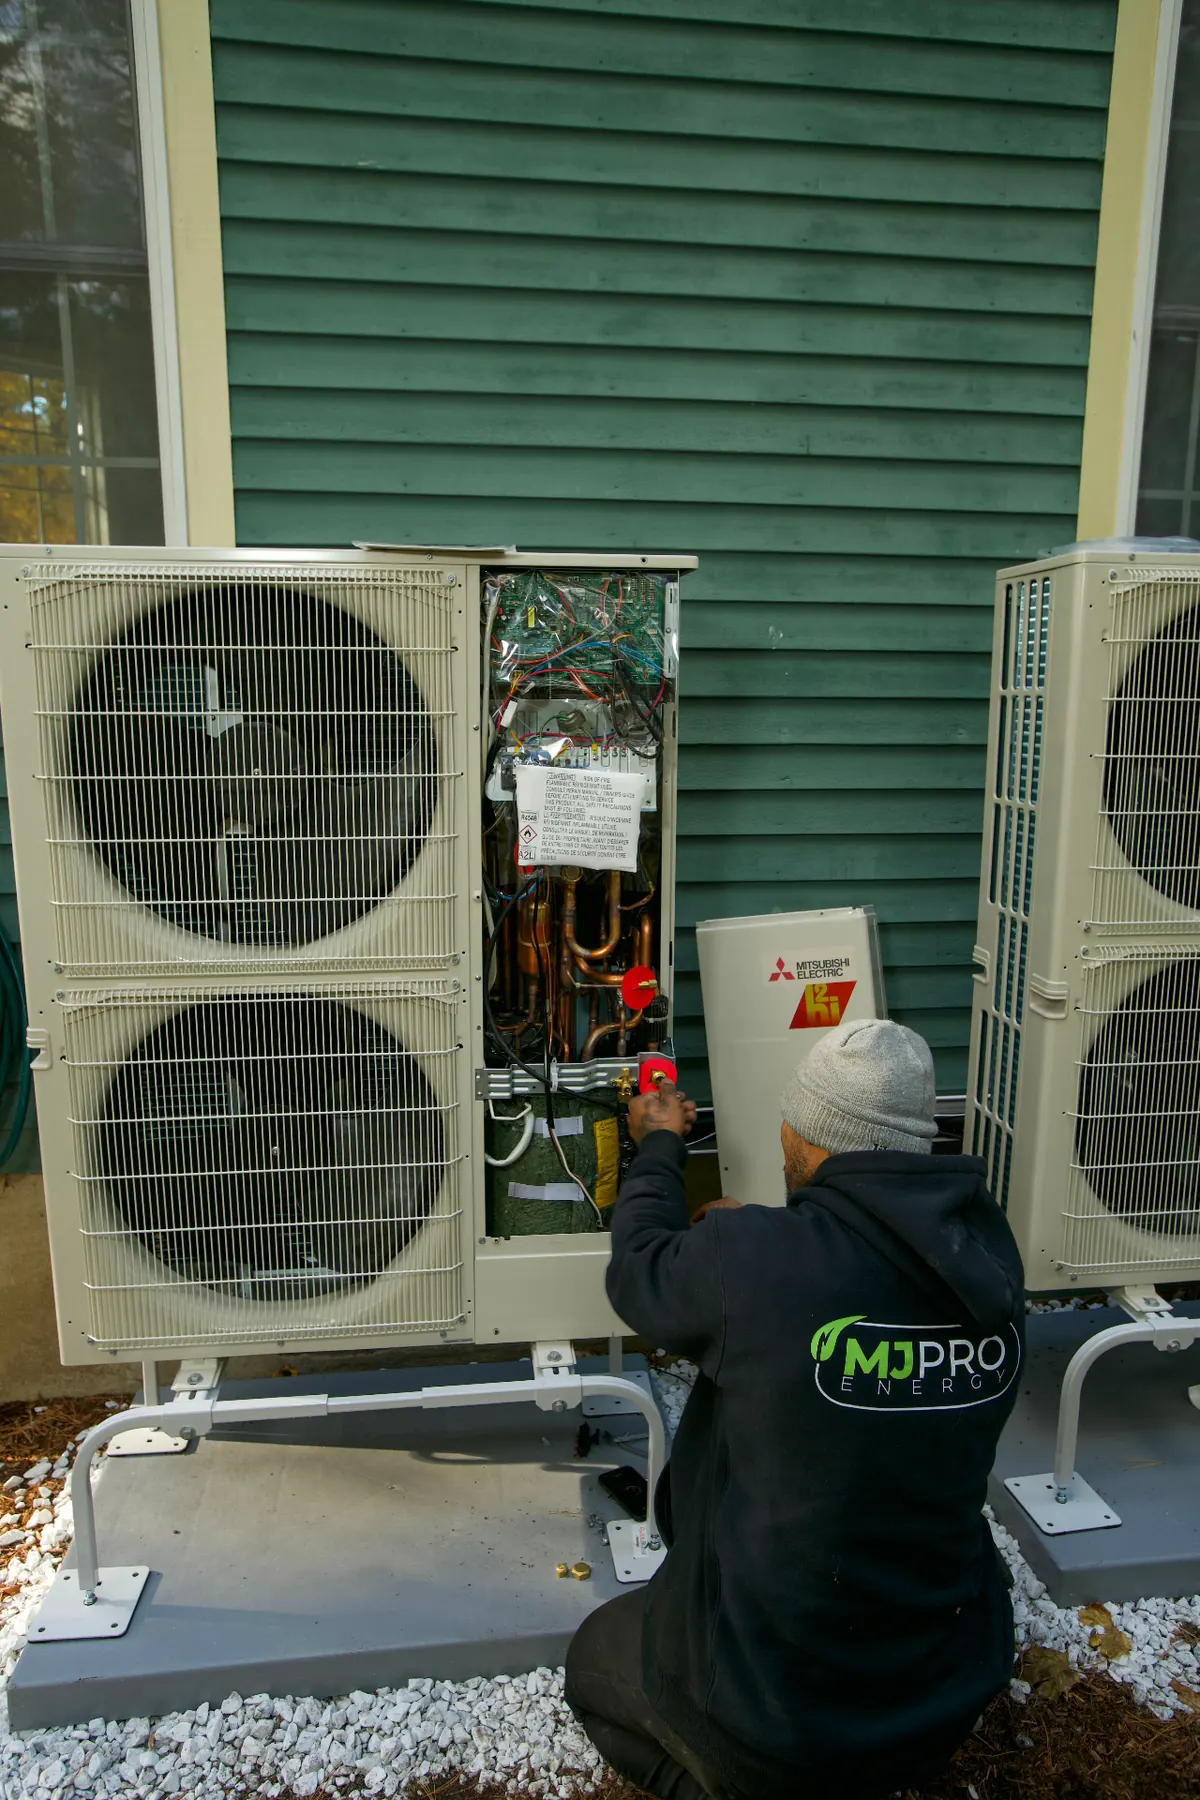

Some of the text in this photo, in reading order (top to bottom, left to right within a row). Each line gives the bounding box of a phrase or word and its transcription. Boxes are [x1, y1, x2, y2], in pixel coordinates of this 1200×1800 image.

[520, 850, 534, 860] A2L
[796, 958, 850, 971] MITSUBISHI
[797, 968, 844, 980] ELECTRIC
[840, 1370, 1005, 1395] ENERGY
